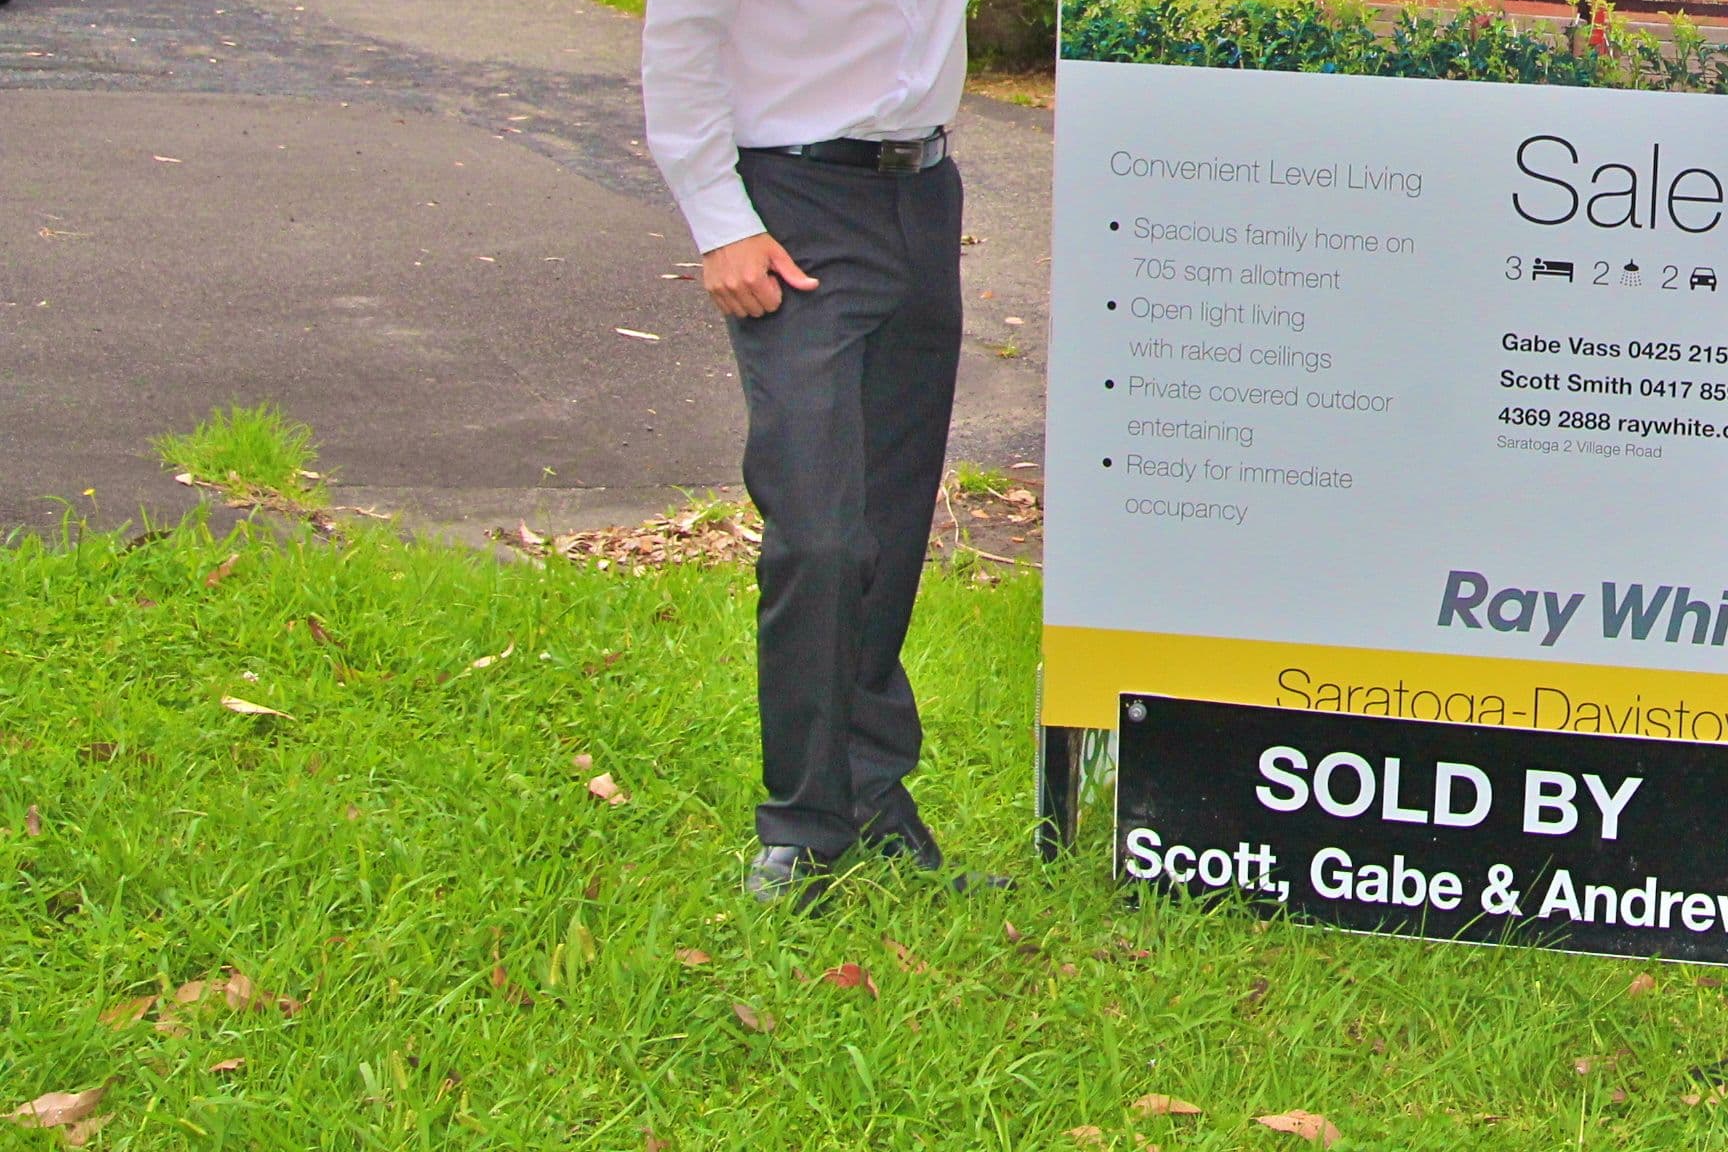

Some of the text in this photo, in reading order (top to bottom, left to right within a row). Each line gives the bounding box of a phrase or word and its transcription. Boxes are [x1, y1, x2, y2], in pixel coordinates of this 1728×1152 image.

[1110, 151, 1423, 197] Convenient Level Living
[1512, 135, 1723, 233] Sale
[1134, 217, 1414, 253] Spacious family home on
[1133, 258, 1340, 290] 705 sqm allotment
[1505, 256, 1522, 280] 3
[1593, 261, 1609, 286] 2
[1662, 265, 1678, 289] 2
[1130, 297, 1305, 332] Open light living
[1129, 340, 1332, 372] with raked ceilings
[1502, 333, 1561, 353] Gabe
[1569, 337, 1621, 357] Vass
[1628, 341, 1681, 361] 0425
[1688, 345, 1728, 364] 215
[1128, 376, 1393, 412] Private covered outdoor
[1500, 370, 1560, 390] Scott
[1568, 374, 1632, 395] Smith
[1639, 378, 1692, 399] 0417
[1128, 418, 1254, 447] entertaining
[1498, 407, 1551, 426] 4369
[1558, 411, 1611, 430] 2888
[1497, 436, 1662, 458] Saratoga 2 Village Road
[1126, 455, 1352, 489] Ready for immediate
[1125, 499, 1248, 525] occupancy
[1438, 570, 1585, 647] Ray
[1255, 745, 1644, 840] SOLD BY
[1125, 827, 1291, 904] Scott,
[1309, 847, 1463, 911] Gabe
[1481, 863, 1524, 916] &
